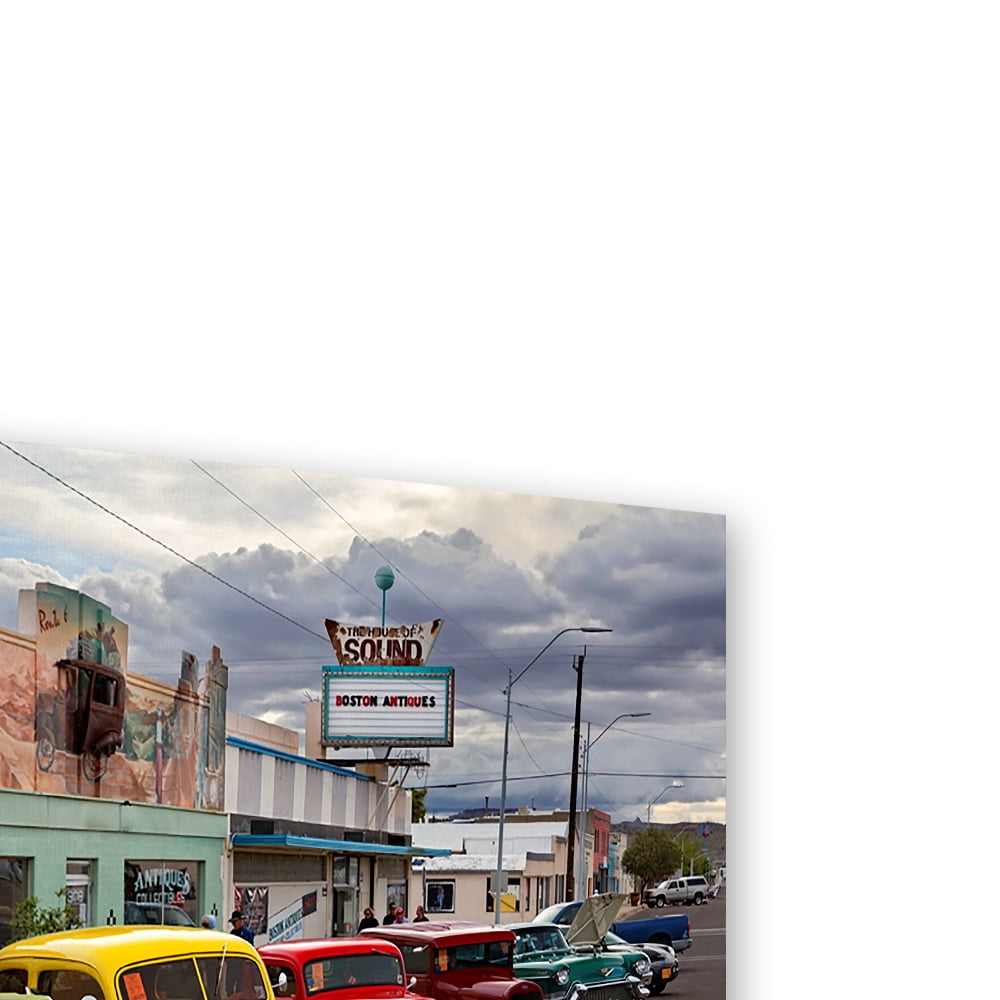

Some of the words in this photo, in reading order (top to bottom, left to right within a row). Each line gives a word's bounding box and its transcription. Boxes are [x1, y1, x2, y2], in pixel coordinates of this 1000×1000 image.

[347, 627, 365, 637] THE
[344, 639, 422, 661] SOUND
[336, 695, 377, 707] BOSTON
[383, 696, 435, 707] ANTIQUES
[134, 868, 190, 895] ANTIQUES
